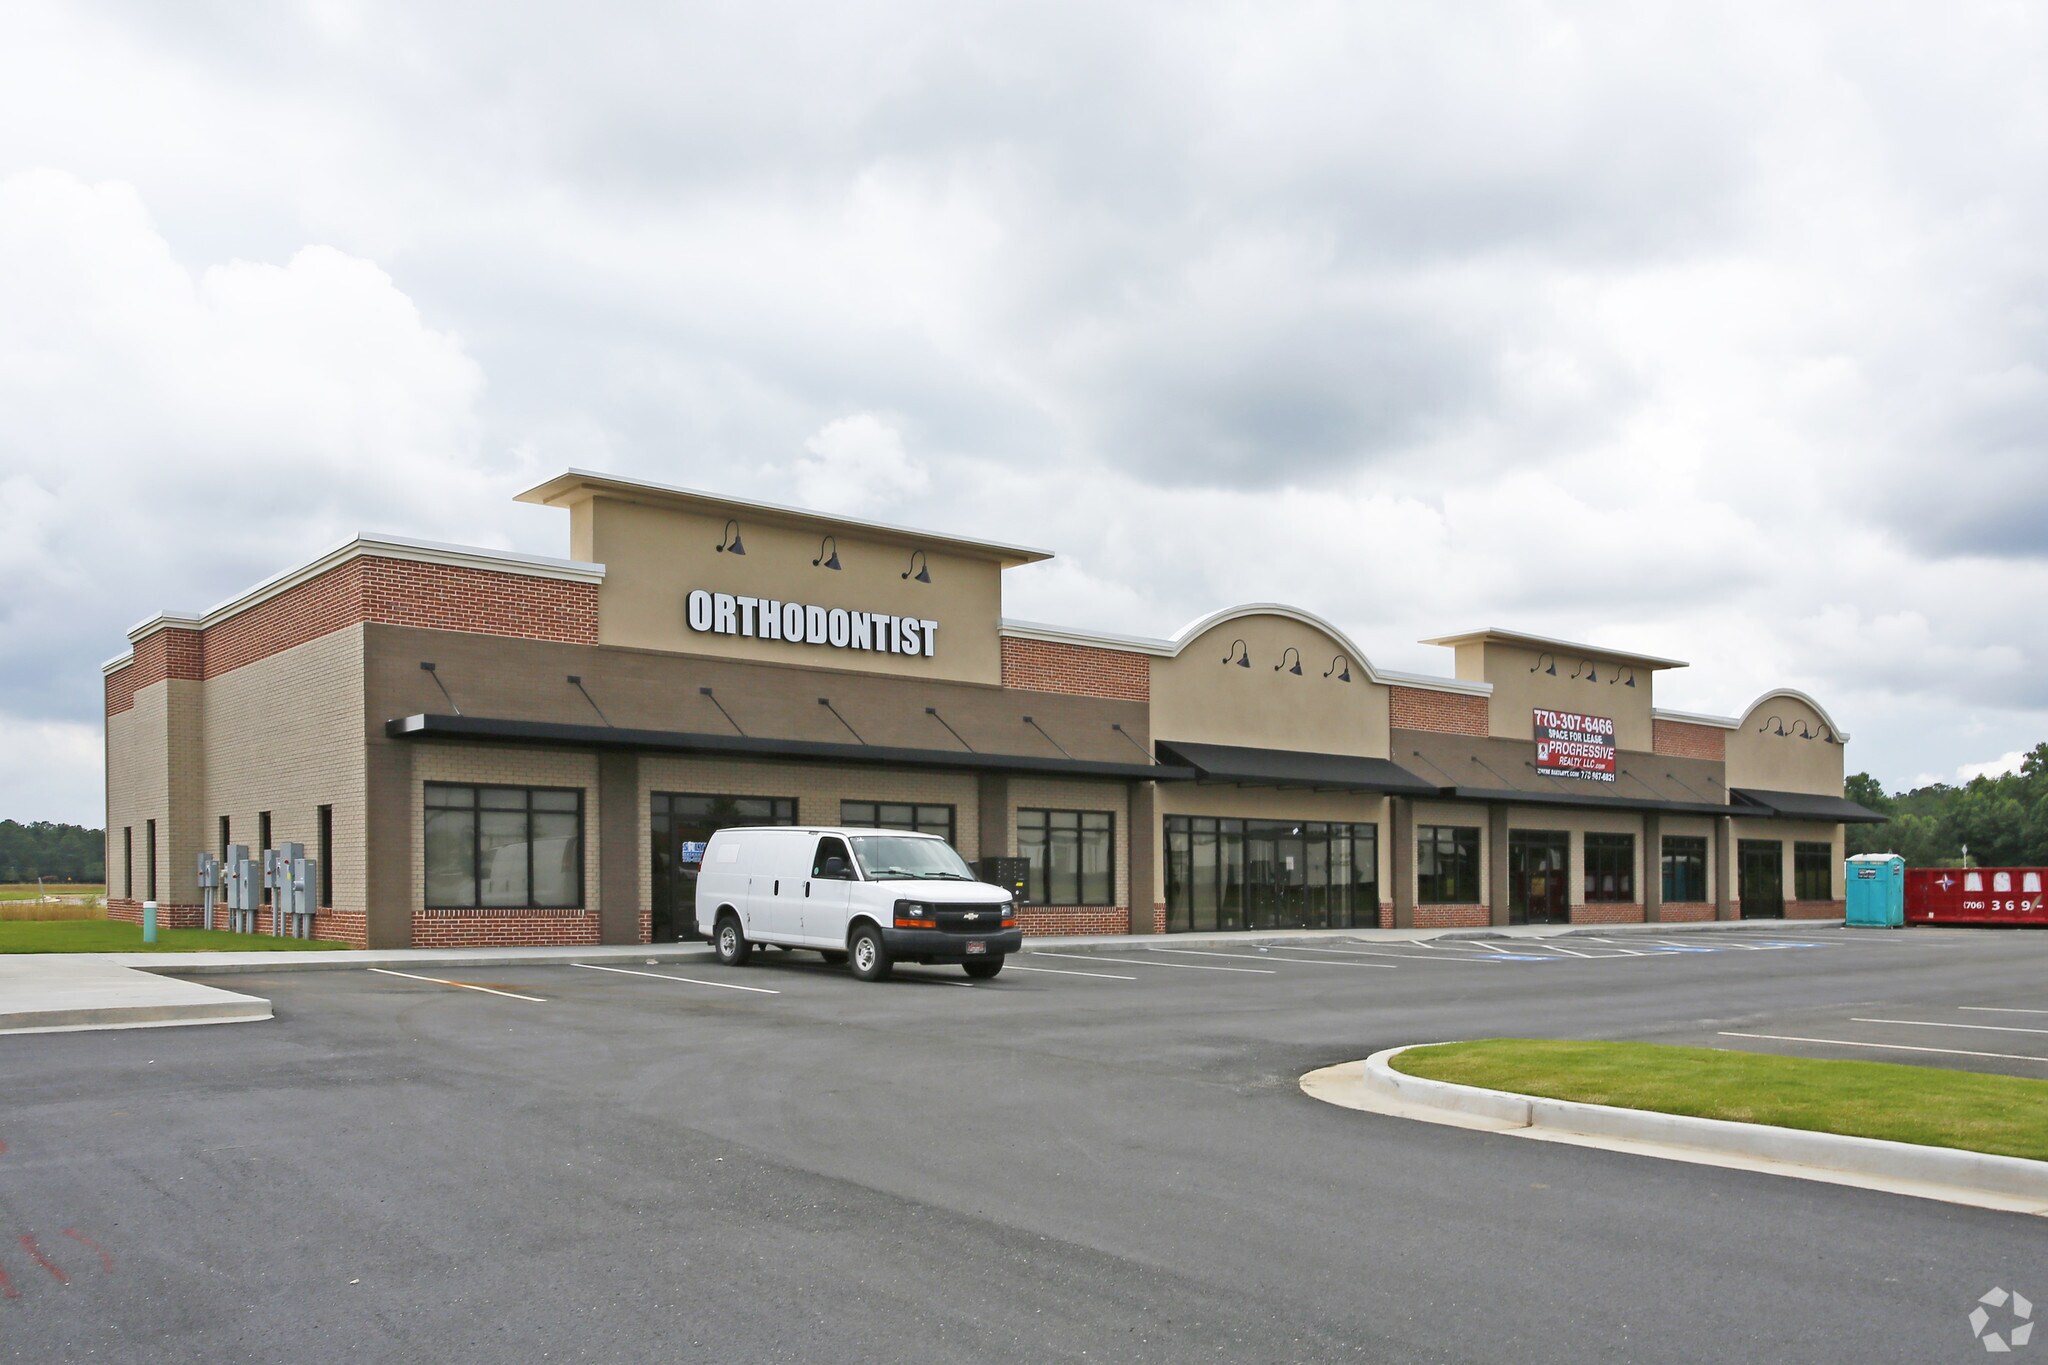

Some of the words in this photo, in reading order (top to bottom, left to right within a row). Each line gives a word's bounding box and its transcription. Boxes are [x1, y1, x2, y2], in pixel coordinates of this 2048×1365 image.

[686, 589, 938, 657] ORTHODONTIST
[1534, 709, 1613, 735] 770-307-6466
[1548, 728, 1569, 740] SPACE
[1569, 730, 1582, 742] FOR
[1583, 732, 1603, 745] LEASE
[1549, 741, 1615, 760] PROGRESSIVE
[1559, 756, 1582, 767] REALTY
[1963, 901, 1985, 910] (706)
